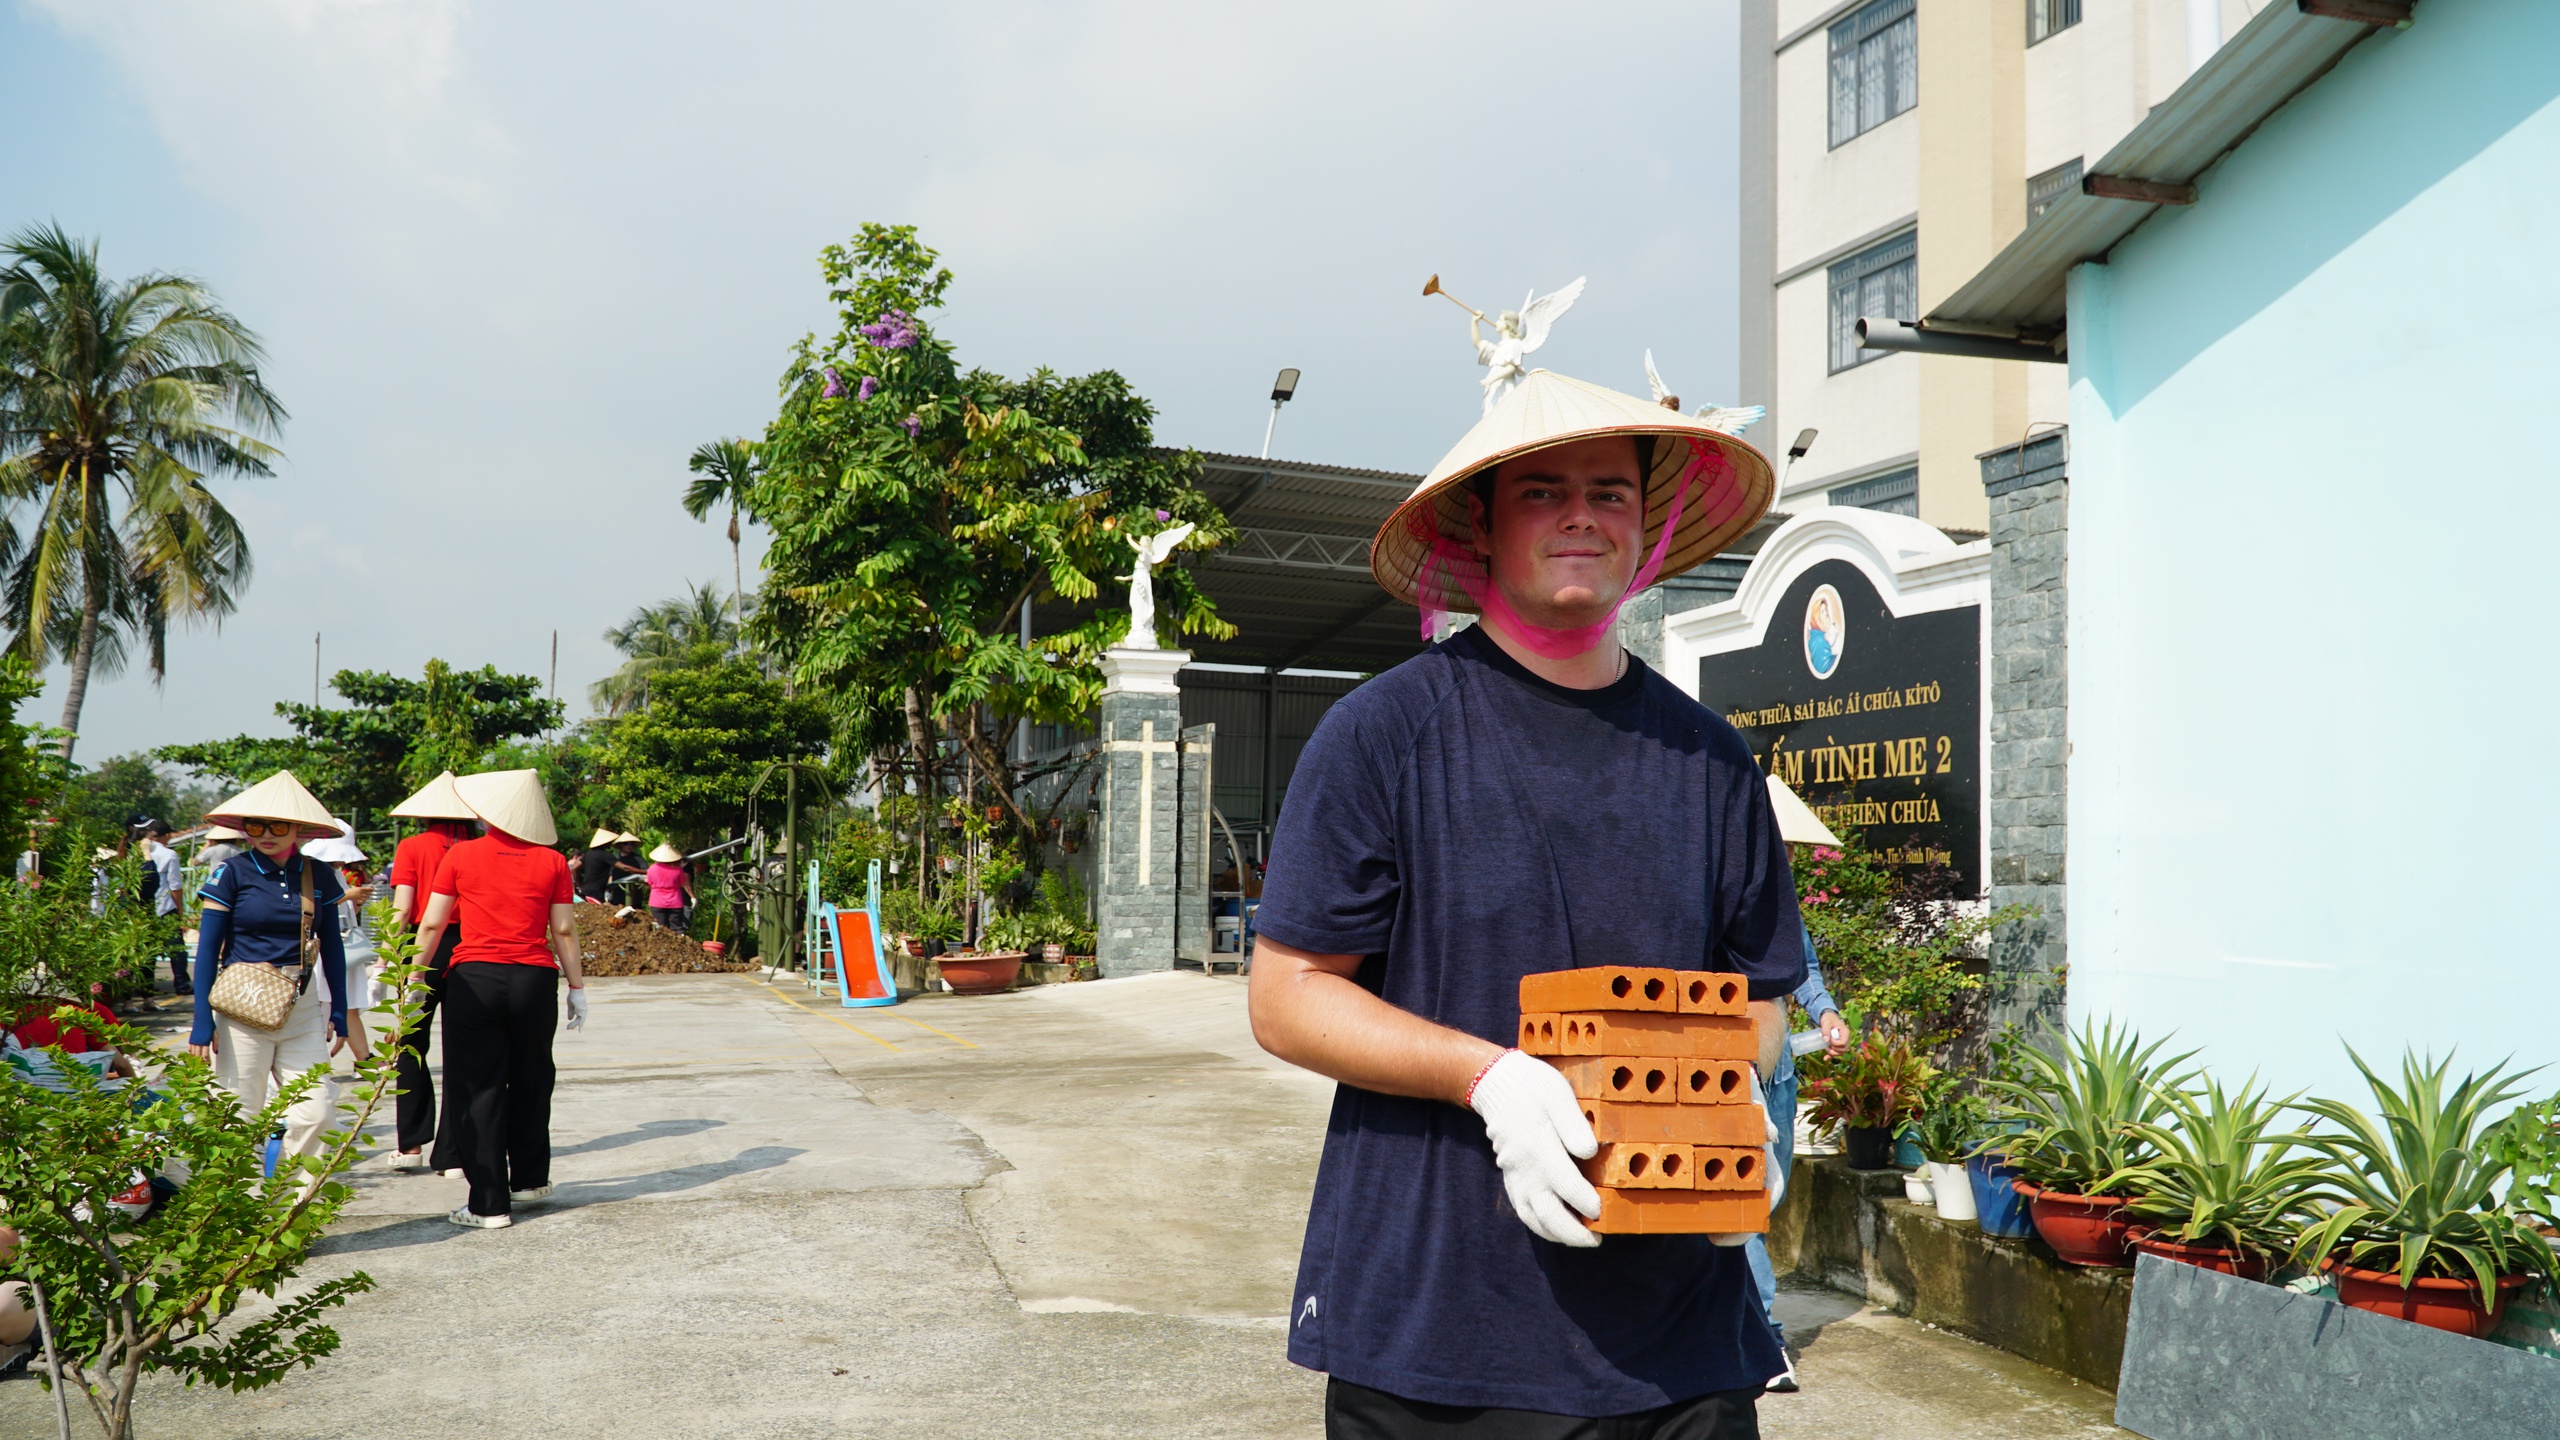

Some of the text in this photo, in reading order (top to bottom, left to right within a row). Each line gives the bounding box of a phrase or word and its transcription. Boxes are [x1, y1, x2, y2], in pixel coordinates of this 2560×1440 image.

[1726, 709, 1757, 729] DÒNG
[1760, 703, 1792, 725] THỪA
[1817, 695, 1843, 718] BÁC
[1863, 686, 1902, 712] CHÚA
[1811, 735, 1877, 784] TÌNH
[1883, 736, 1927, 786] MẸ
[1936, 735, 1952, 774] 2
[1891, 792, 1941, 824] CHÚA
